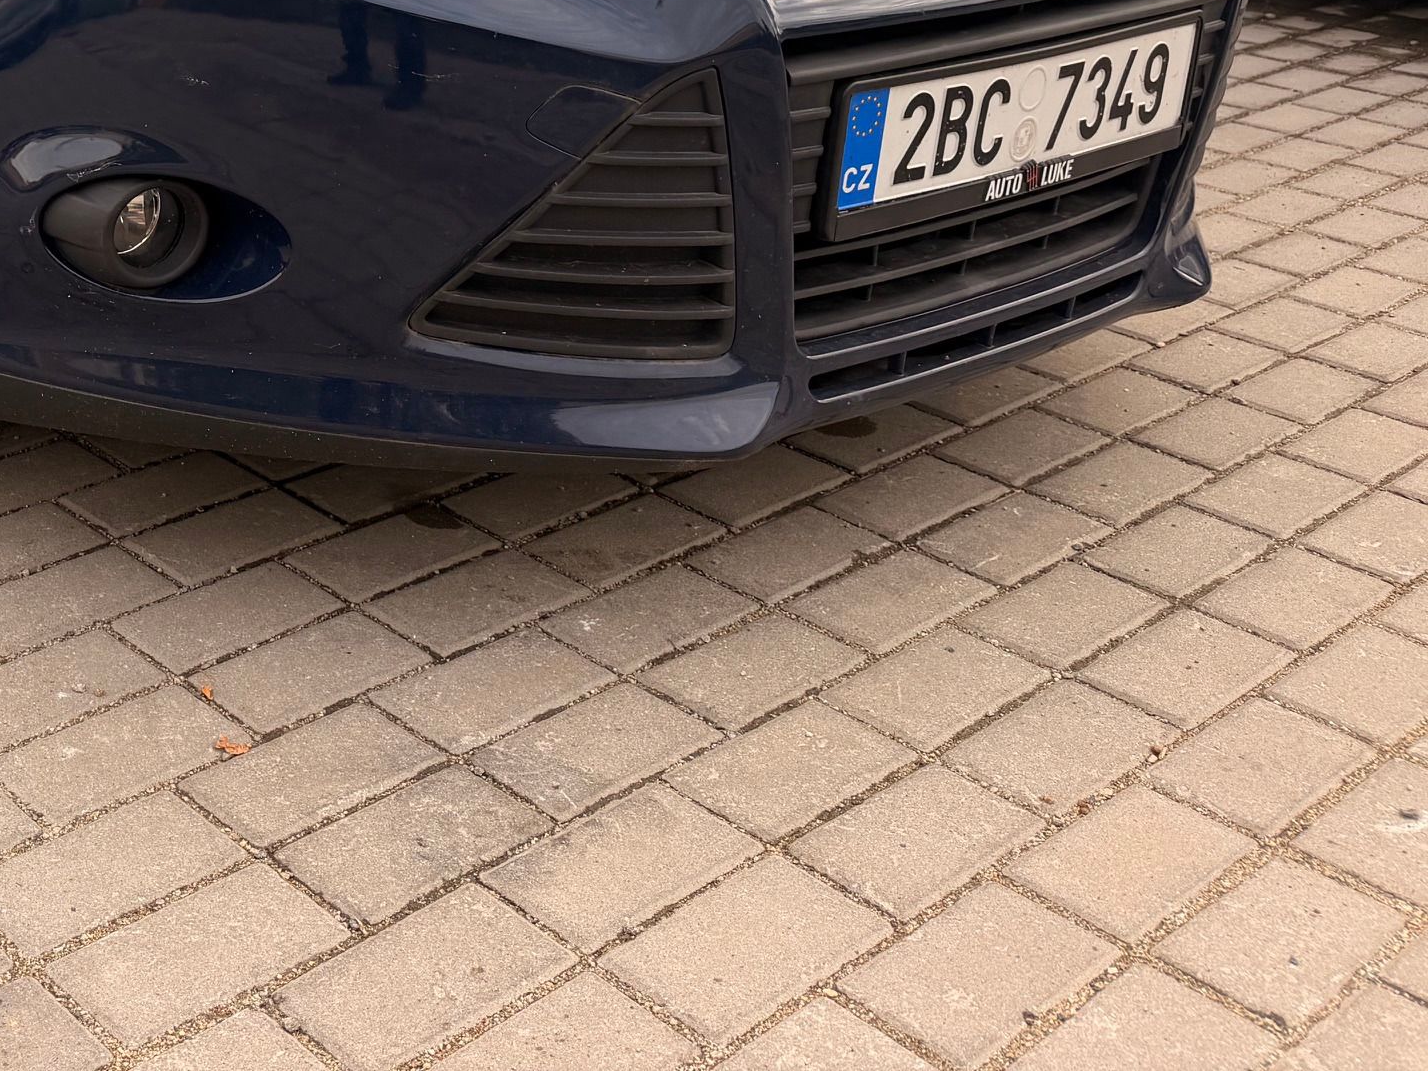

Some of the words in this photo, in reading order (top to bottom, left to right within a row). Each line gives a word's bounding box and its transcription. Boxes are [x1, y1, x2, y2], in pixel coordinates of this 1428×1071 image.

[893, 78, 1011, 186] 2BC
[1044, 42, 1171, 152] 7349
[842, 163, 873, 194] CZ
[985, 173, 1023, 201] AUTO
[1041, 159, 1074, 186] LUKE
